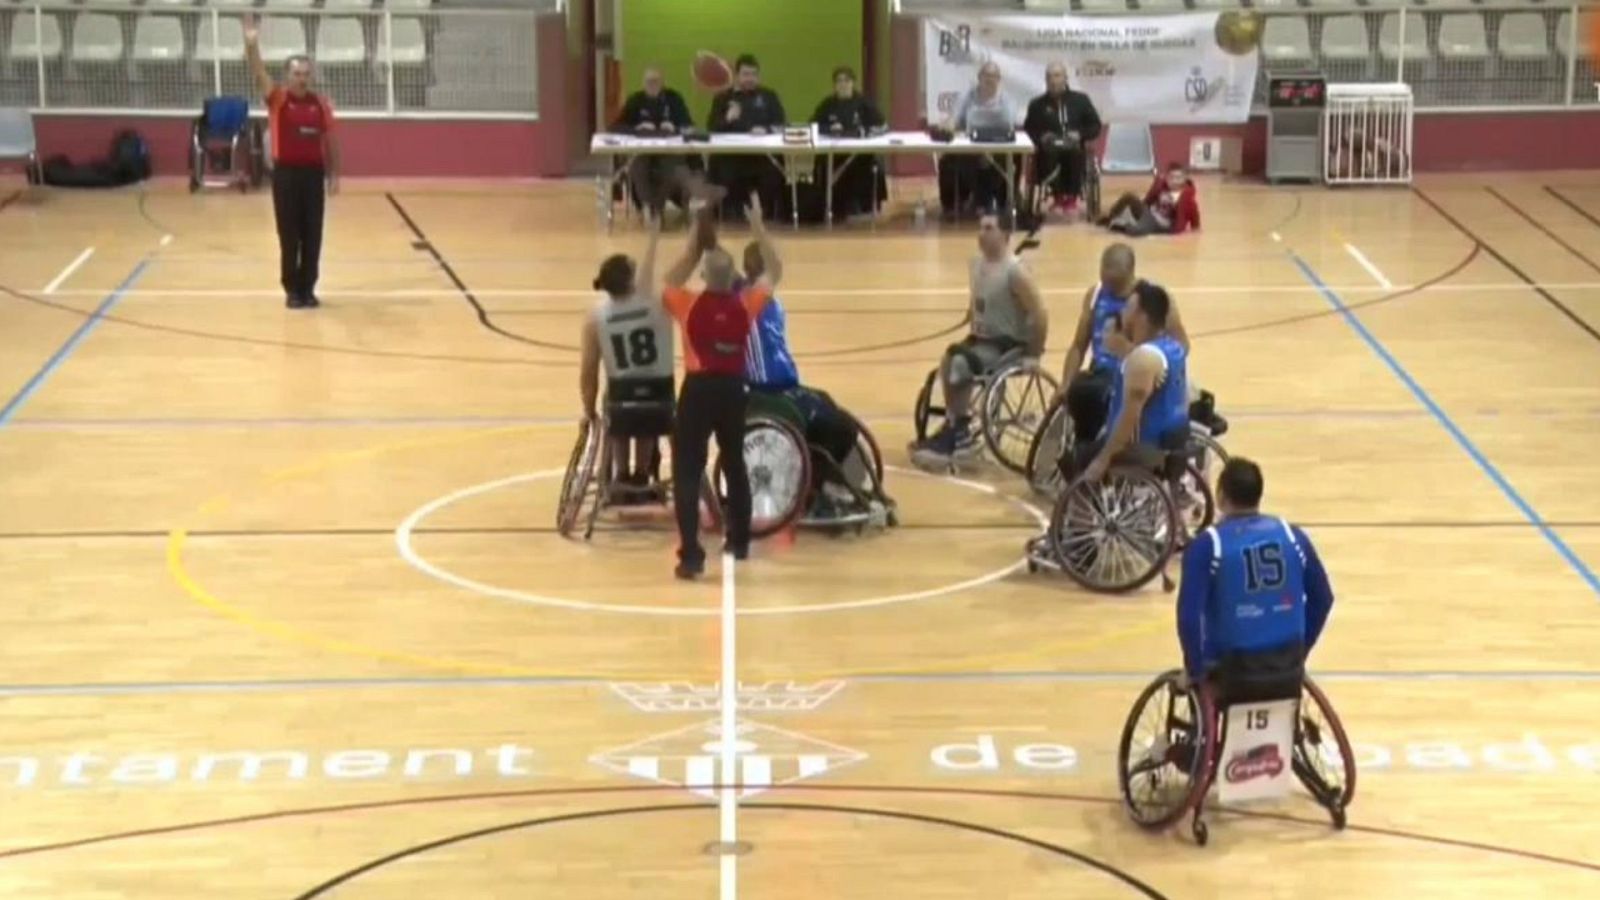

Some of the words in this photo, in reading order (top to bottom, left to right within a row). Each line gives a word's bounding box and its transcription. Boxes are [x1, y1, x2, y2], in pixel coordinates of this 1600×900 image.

[1037, 28, 1064, 38] LIGA
[1066, 28, 1121, 37] NACIONAL
[610, 327, 659, 371] 18
[1242, 541, 1287, 594] 15
[1246, 709, 1269, 731] 15
[930, 733, 1078, 771] de
